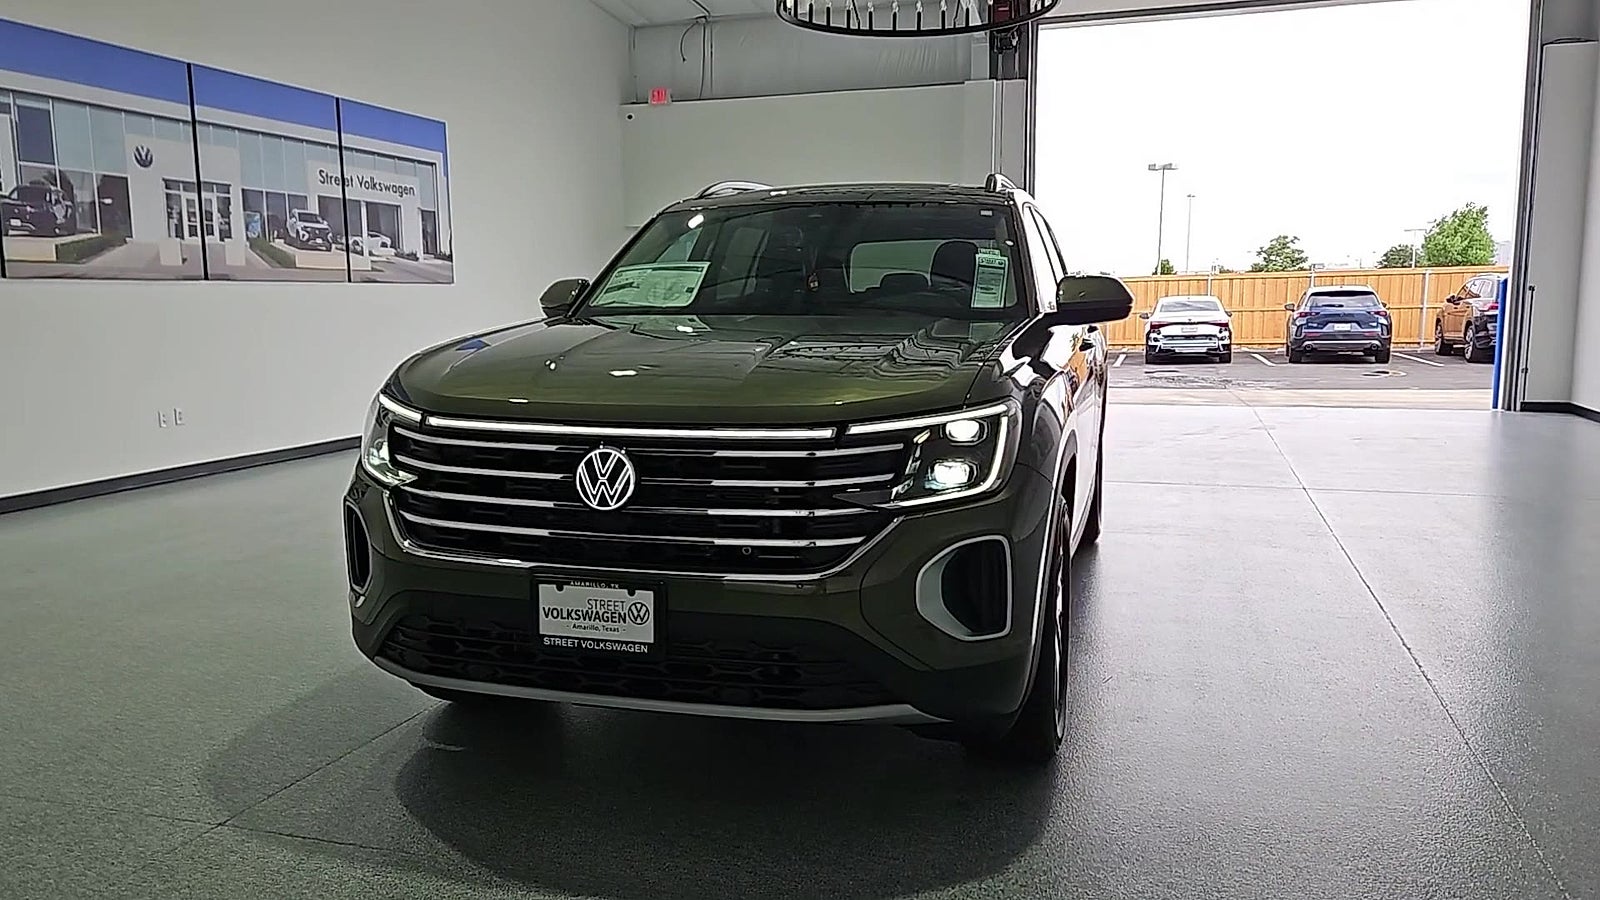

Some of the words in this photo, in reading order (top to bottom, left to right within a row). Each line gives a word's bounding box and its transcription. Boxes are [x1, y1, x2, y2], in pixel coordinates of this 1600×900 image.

[318, 169, 354, 188] Street
[356, 174, 415, 198] Volkswagen
[587, 598, 626, 612] STREET
[542, 606, 627, 624] VOLKSWAGEN
[572, 623, 601, 632] Amarillo,
[602, 625, 619, 633] Texas
[543, 637, 579, 648] STREET
[580, 640, 648, 653] VOLKSWAGEN
